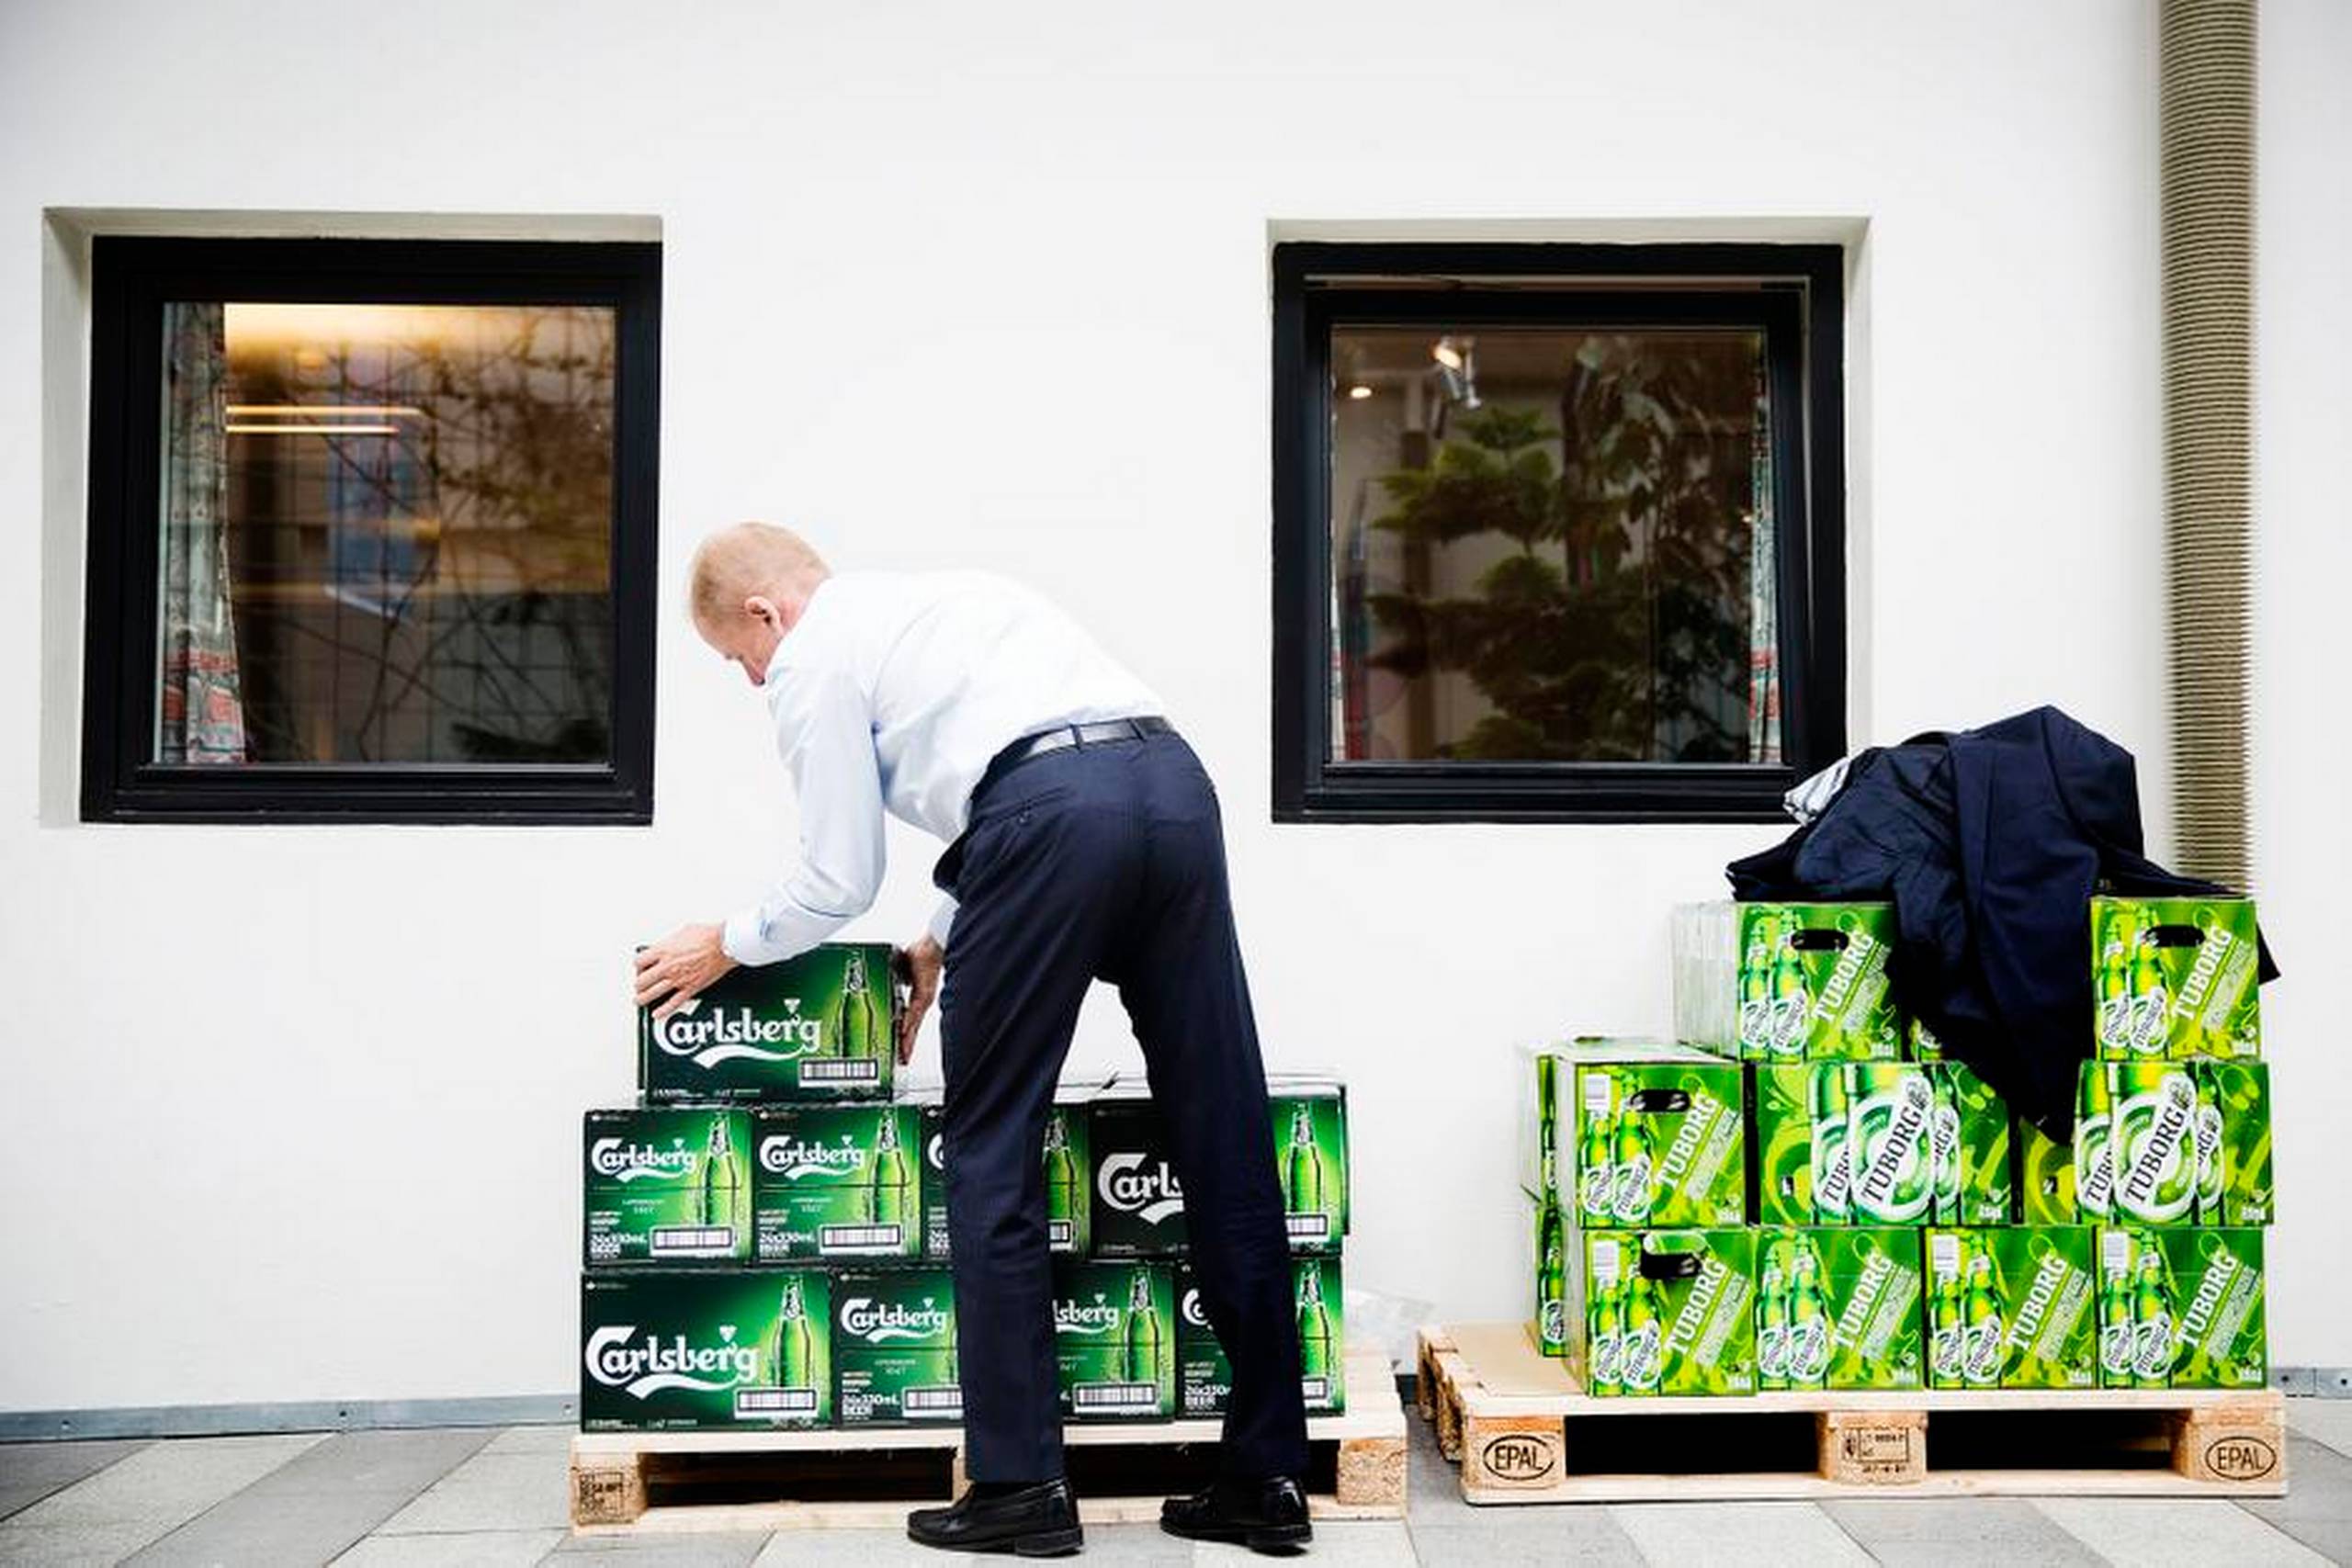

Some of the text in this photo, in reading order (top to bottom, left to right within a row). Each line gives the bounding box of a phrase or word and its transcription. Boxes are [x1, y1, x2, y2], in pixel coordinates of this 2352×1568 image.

[1812, 929, 1874, 1021] TUBORG
[2172, 926, 2232, 1020] TUBORG
[653, 998, 821, 1068] Carlsberg
[592, 1137, 696, 1182] Carlsberg
[760, 1135, 865, 1179] Carlsberg
[1656, 1091, 1719, 1190] TUBORG
[1861, 1107, 1922, 1202] TUBORG
[2124, 1107, 2185, 1202] TUBORG
[841, 1297, 947, 1342] Carlsberg
[1665, 1258, 1727, 1354] TUBORG
[1834, 1250, 1893, 1348] TUBORG
[2006, 1252, 2068, 1349] TUBORG
[2176, 1249, 2238, 1348] TUBORG
[585, 1325, 759, 1398] Carlsberg
[1495, 1445, 1543, 1470] EPAL
[2218, 1447, 2265, 1470] EPAL
